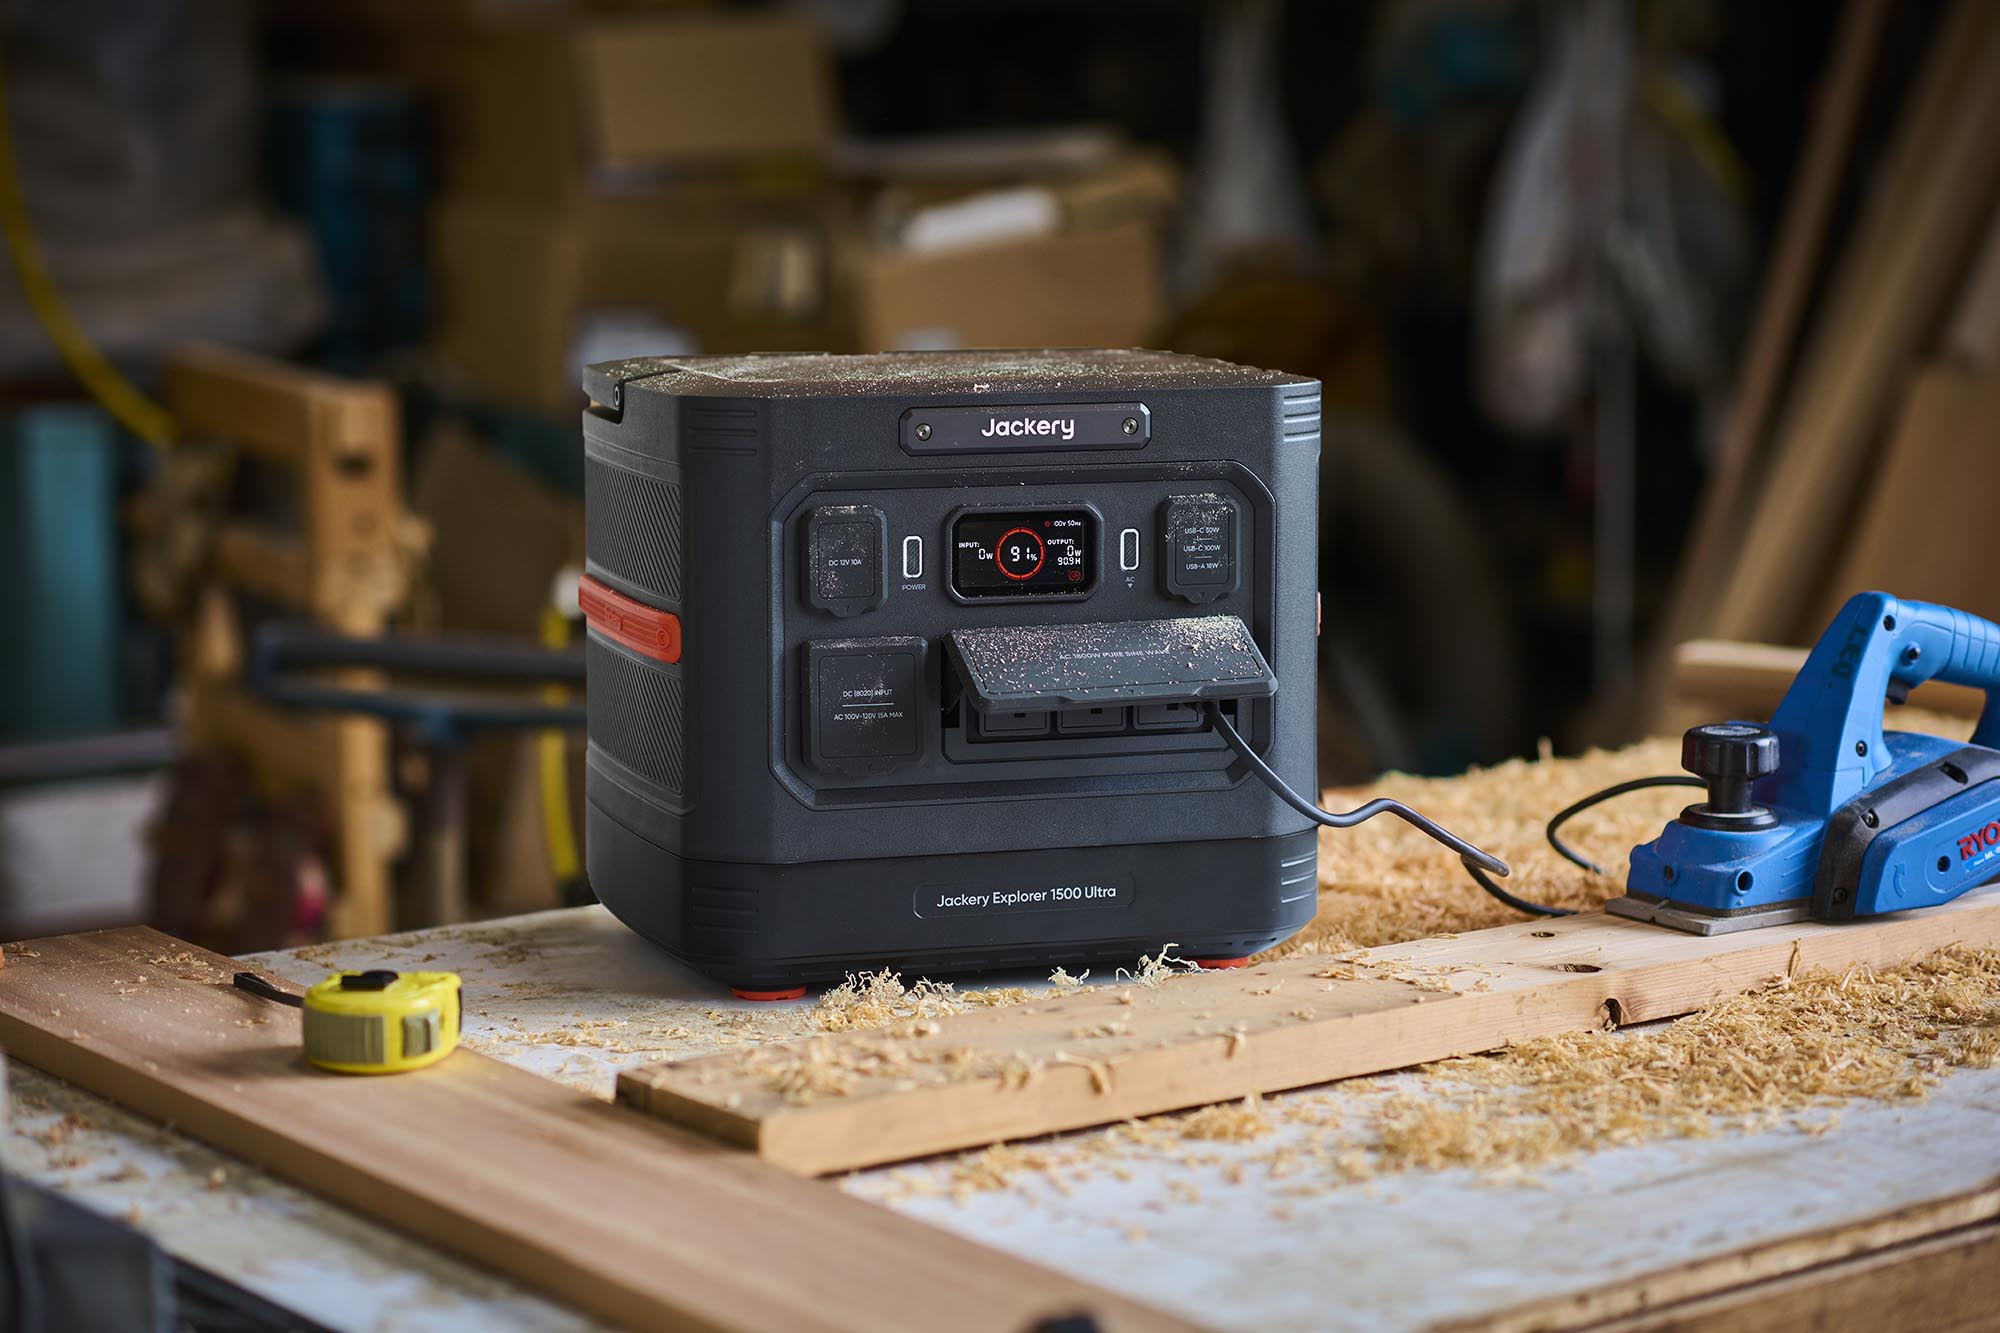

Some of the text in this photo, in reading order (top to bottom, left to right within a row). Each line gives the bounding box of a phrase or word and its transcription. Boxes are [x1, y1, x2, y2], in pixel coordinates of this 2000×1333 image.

[981, 418, 1074, 440] Jackery
[936, 886, 1116, 908] Jackery Explorer 1500 Ultra
